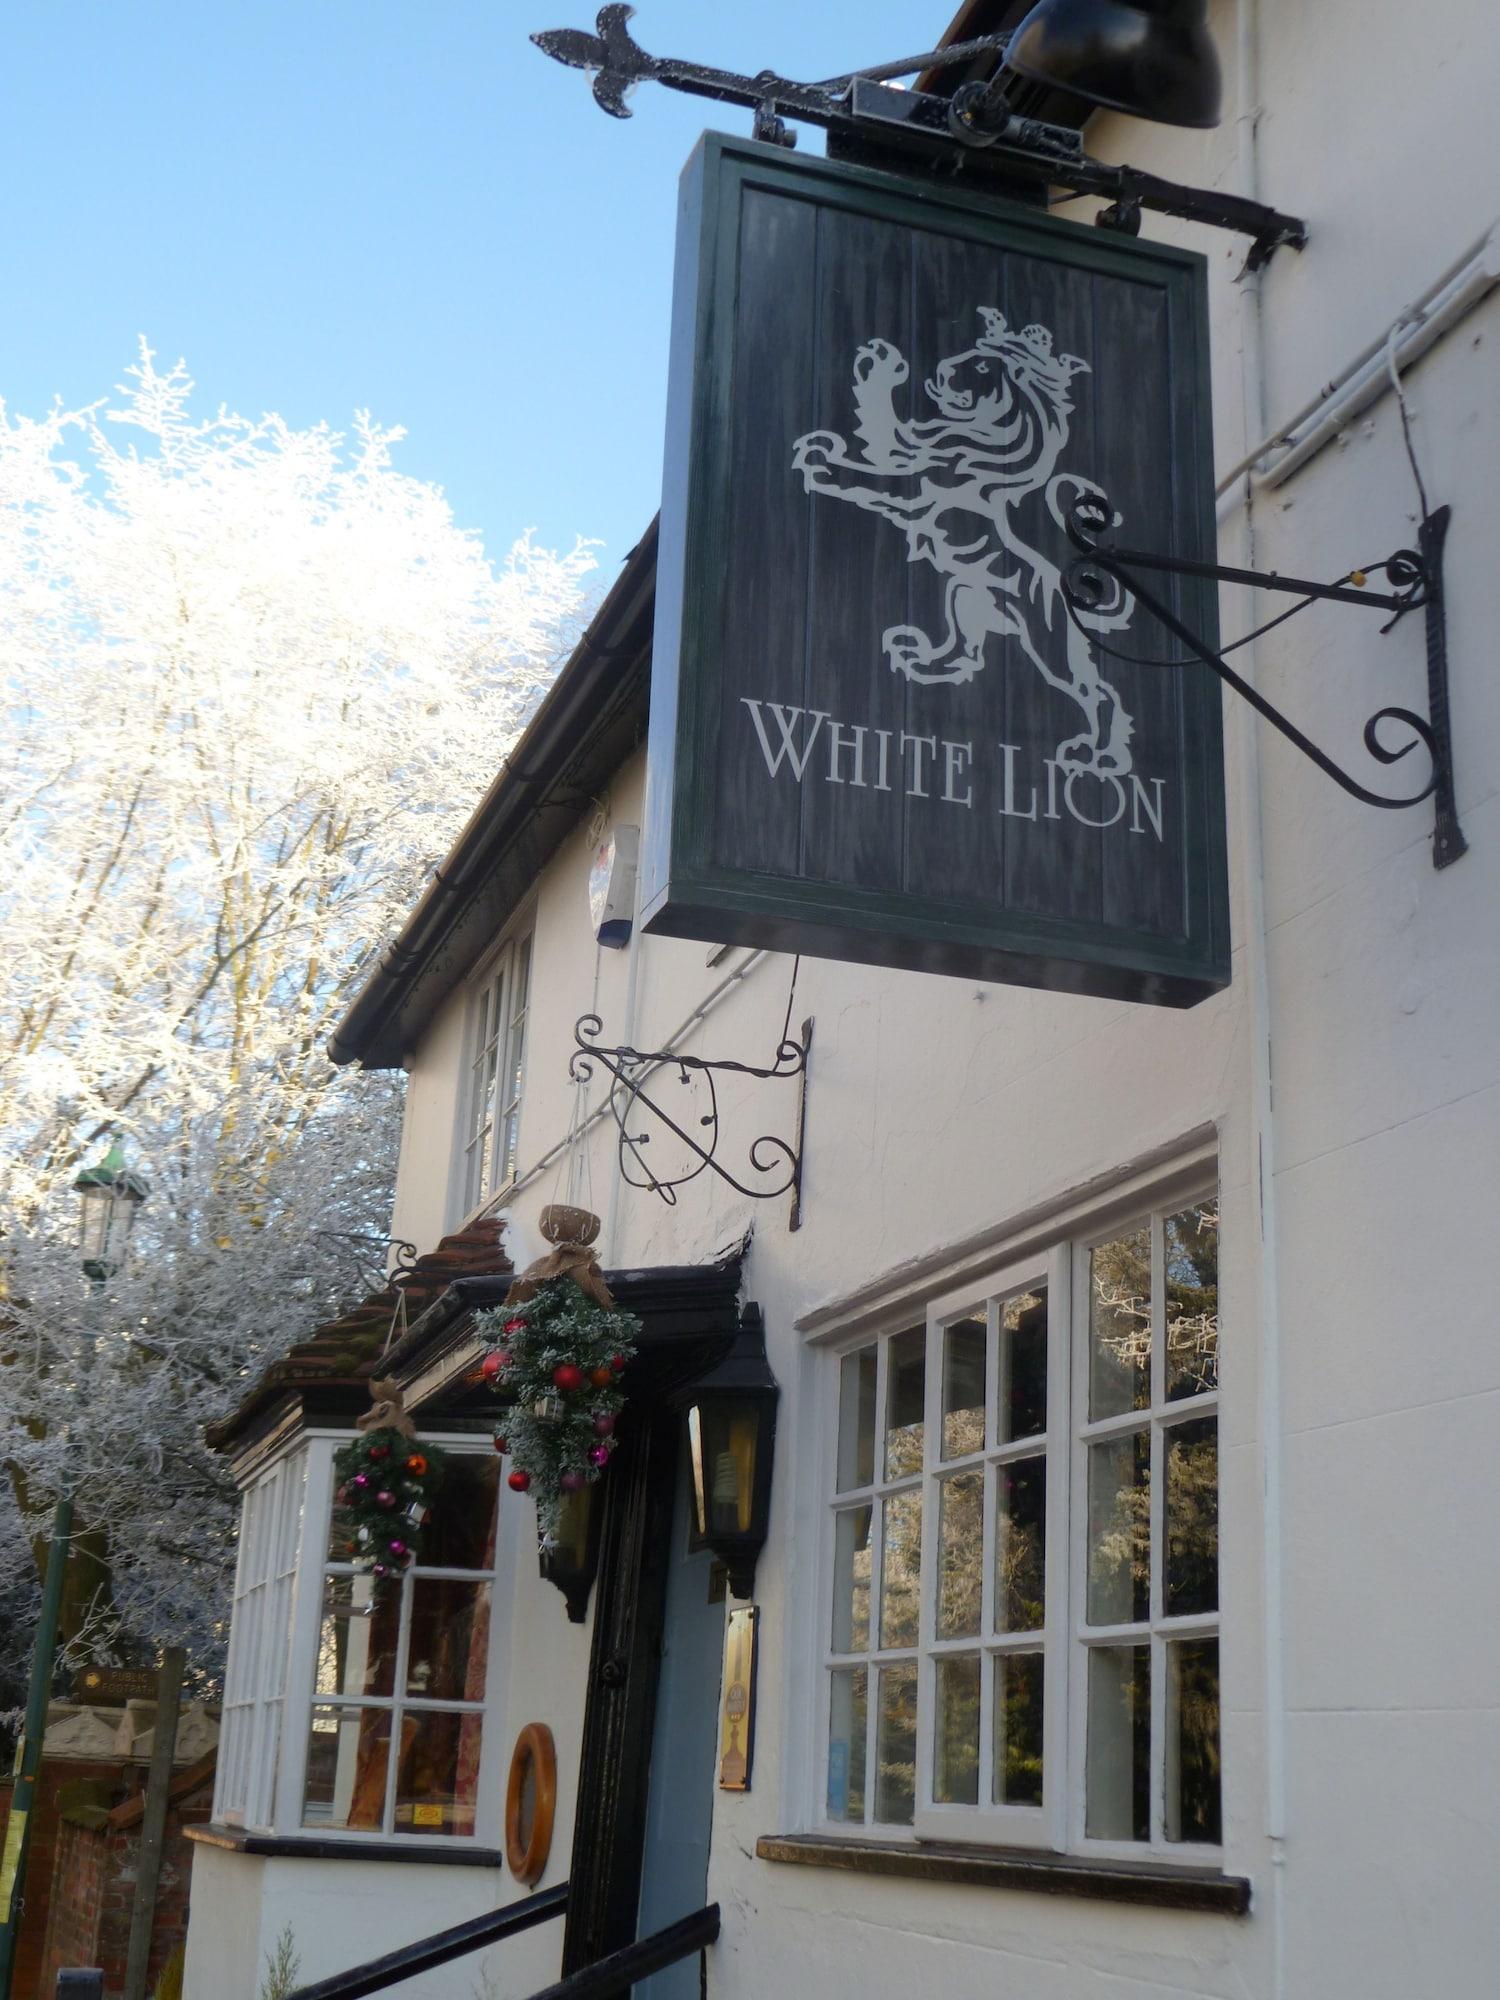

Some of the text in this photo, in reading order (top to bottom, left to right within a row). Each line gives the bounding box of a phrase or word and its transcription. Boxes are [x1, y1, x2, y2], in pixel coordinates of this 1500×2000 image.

[740, 698, 1166, 842] WHITE LION
[111, 1671, 148, 1683] PUBLIC
[102, 1682, 155, 1695] FOOTPATH
